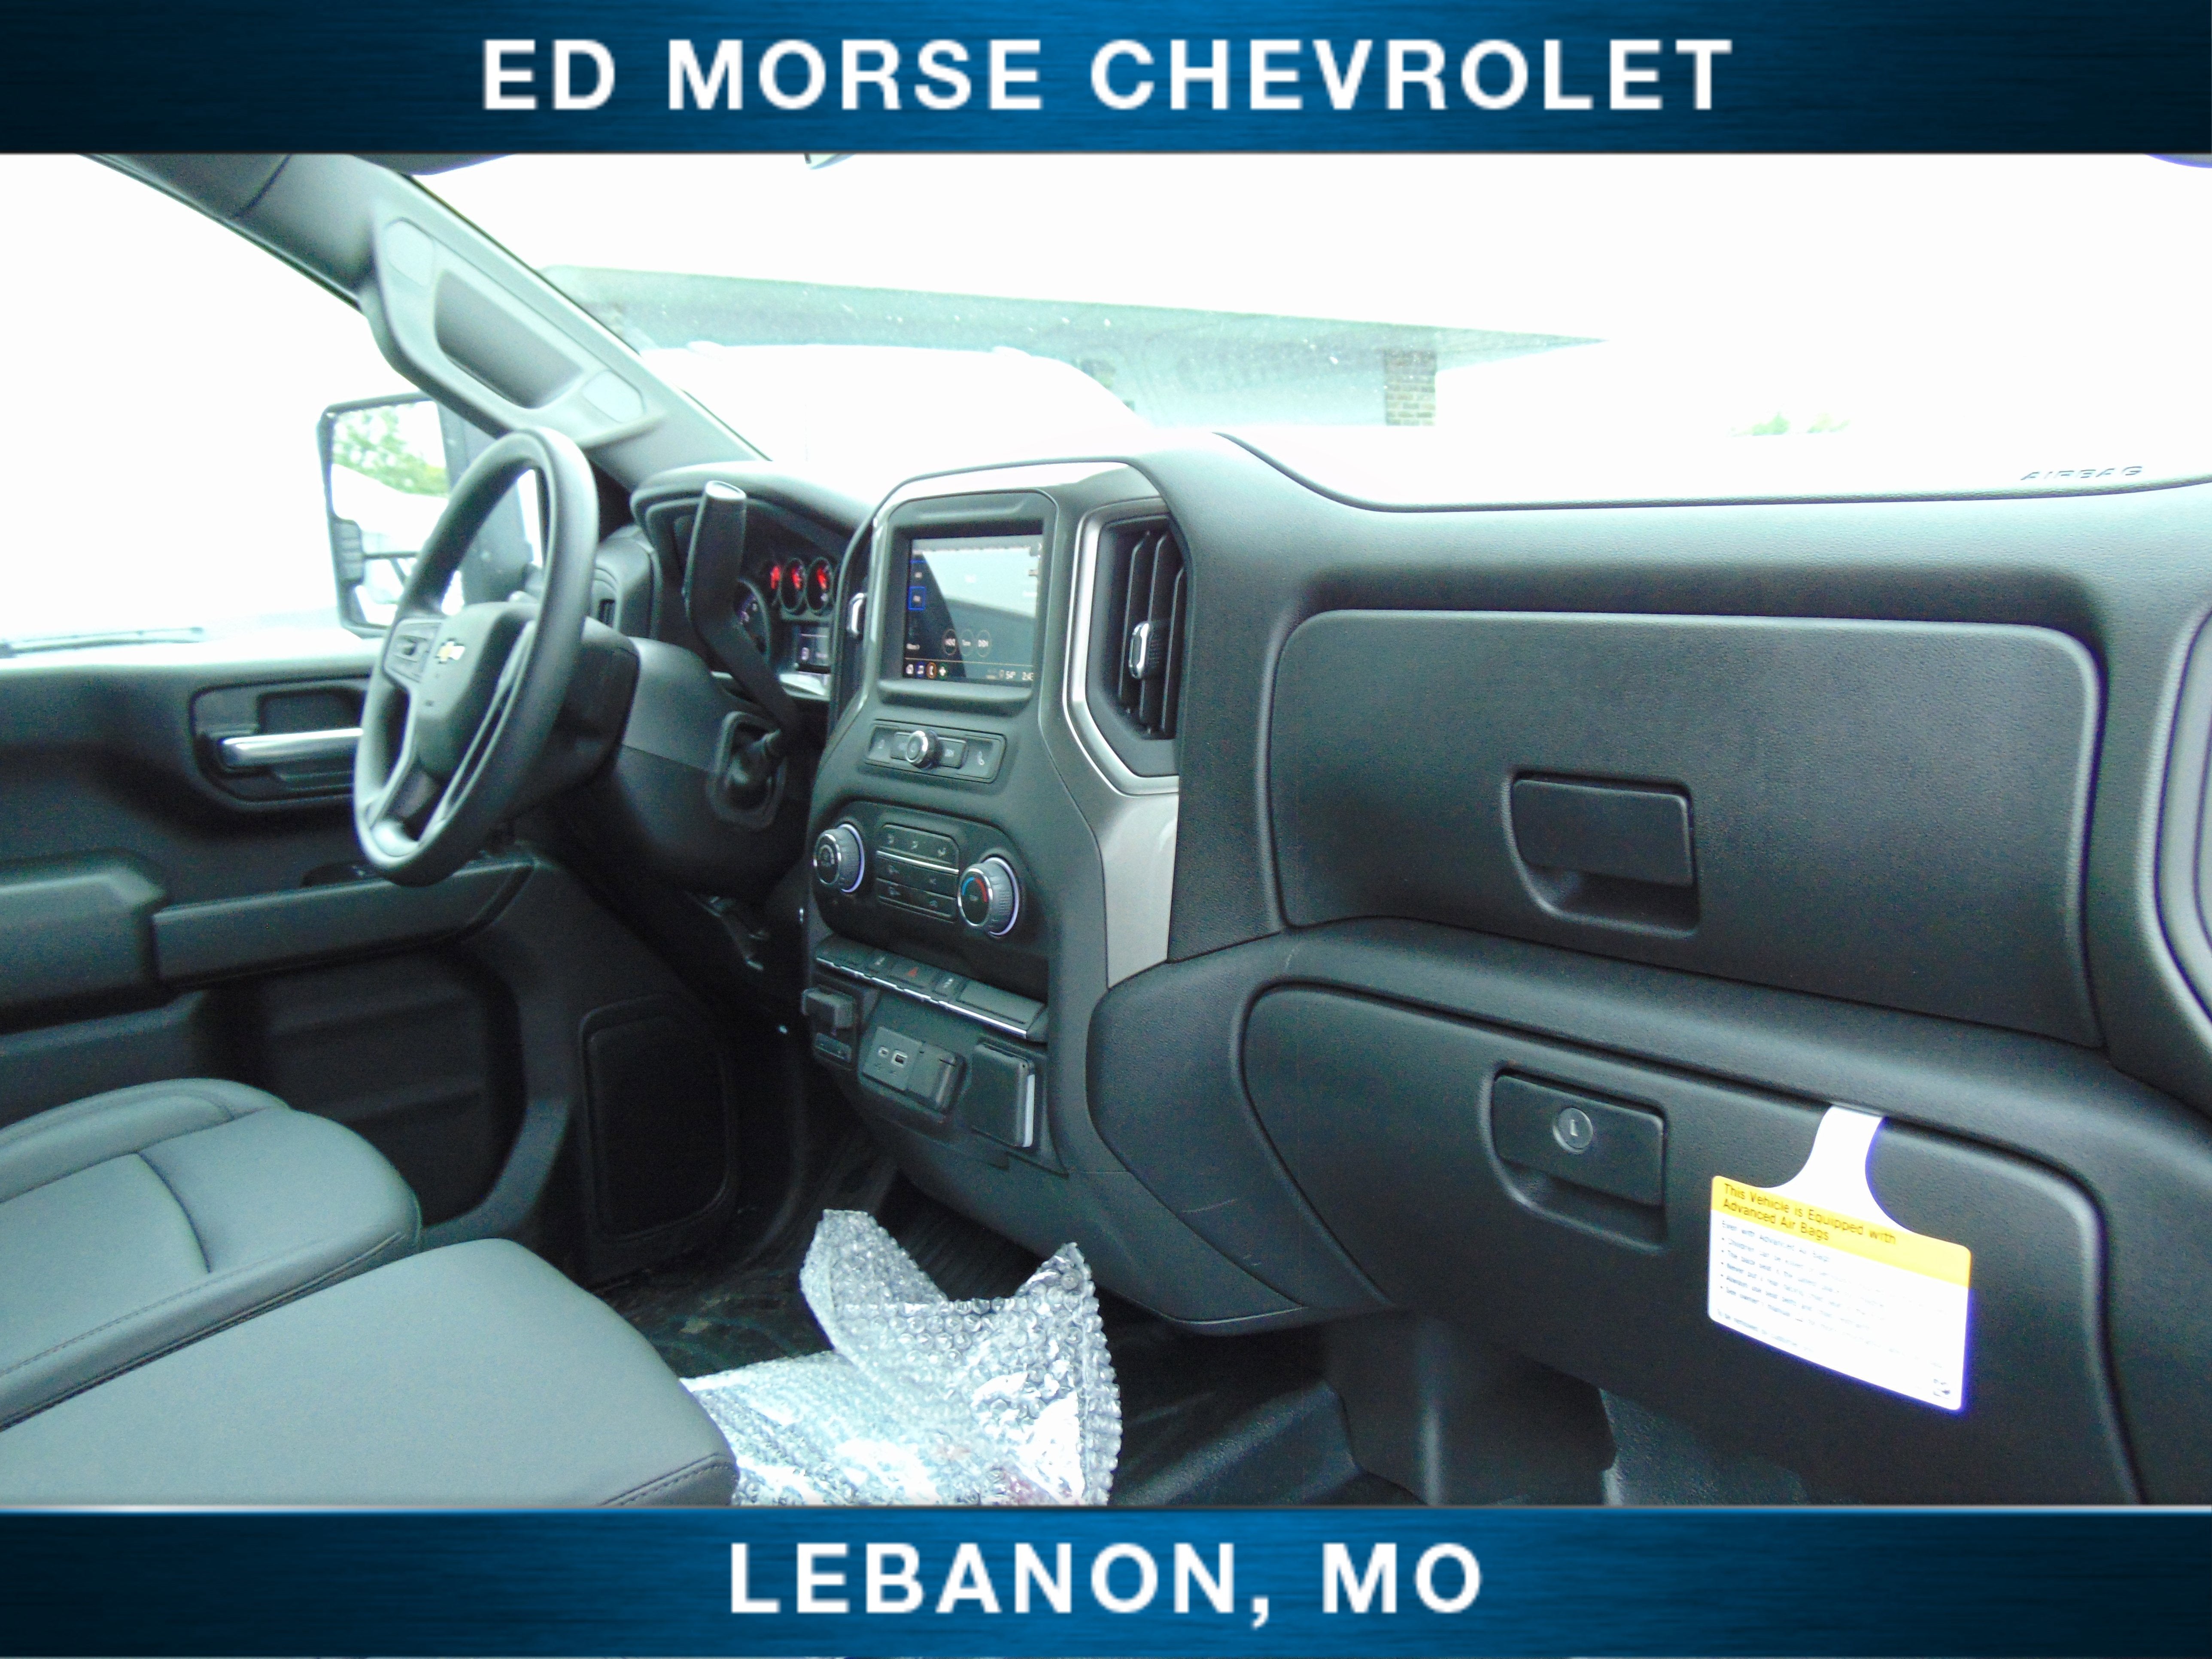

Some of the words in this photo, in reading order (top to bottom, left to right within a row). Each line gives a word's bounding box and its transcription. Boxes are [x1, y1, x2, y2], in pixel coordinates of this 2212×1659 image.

[2020, 466, 2143, 480] AIRBAG
[1723, 1198, 1776, 1224] Advanced
[1781, 1216, 1796, 1229] Air
[1801, 1222, 1829, 1241] Bags
[1724, 1183, 1745, 1200] This
[1750, 1191, 1790, 1213] Vehicle
[1795, 1207, 1803, 1217] is
[1808, 1209, 1863, 1235] Equipped
[1870, 1230, 1896, 1244] with
